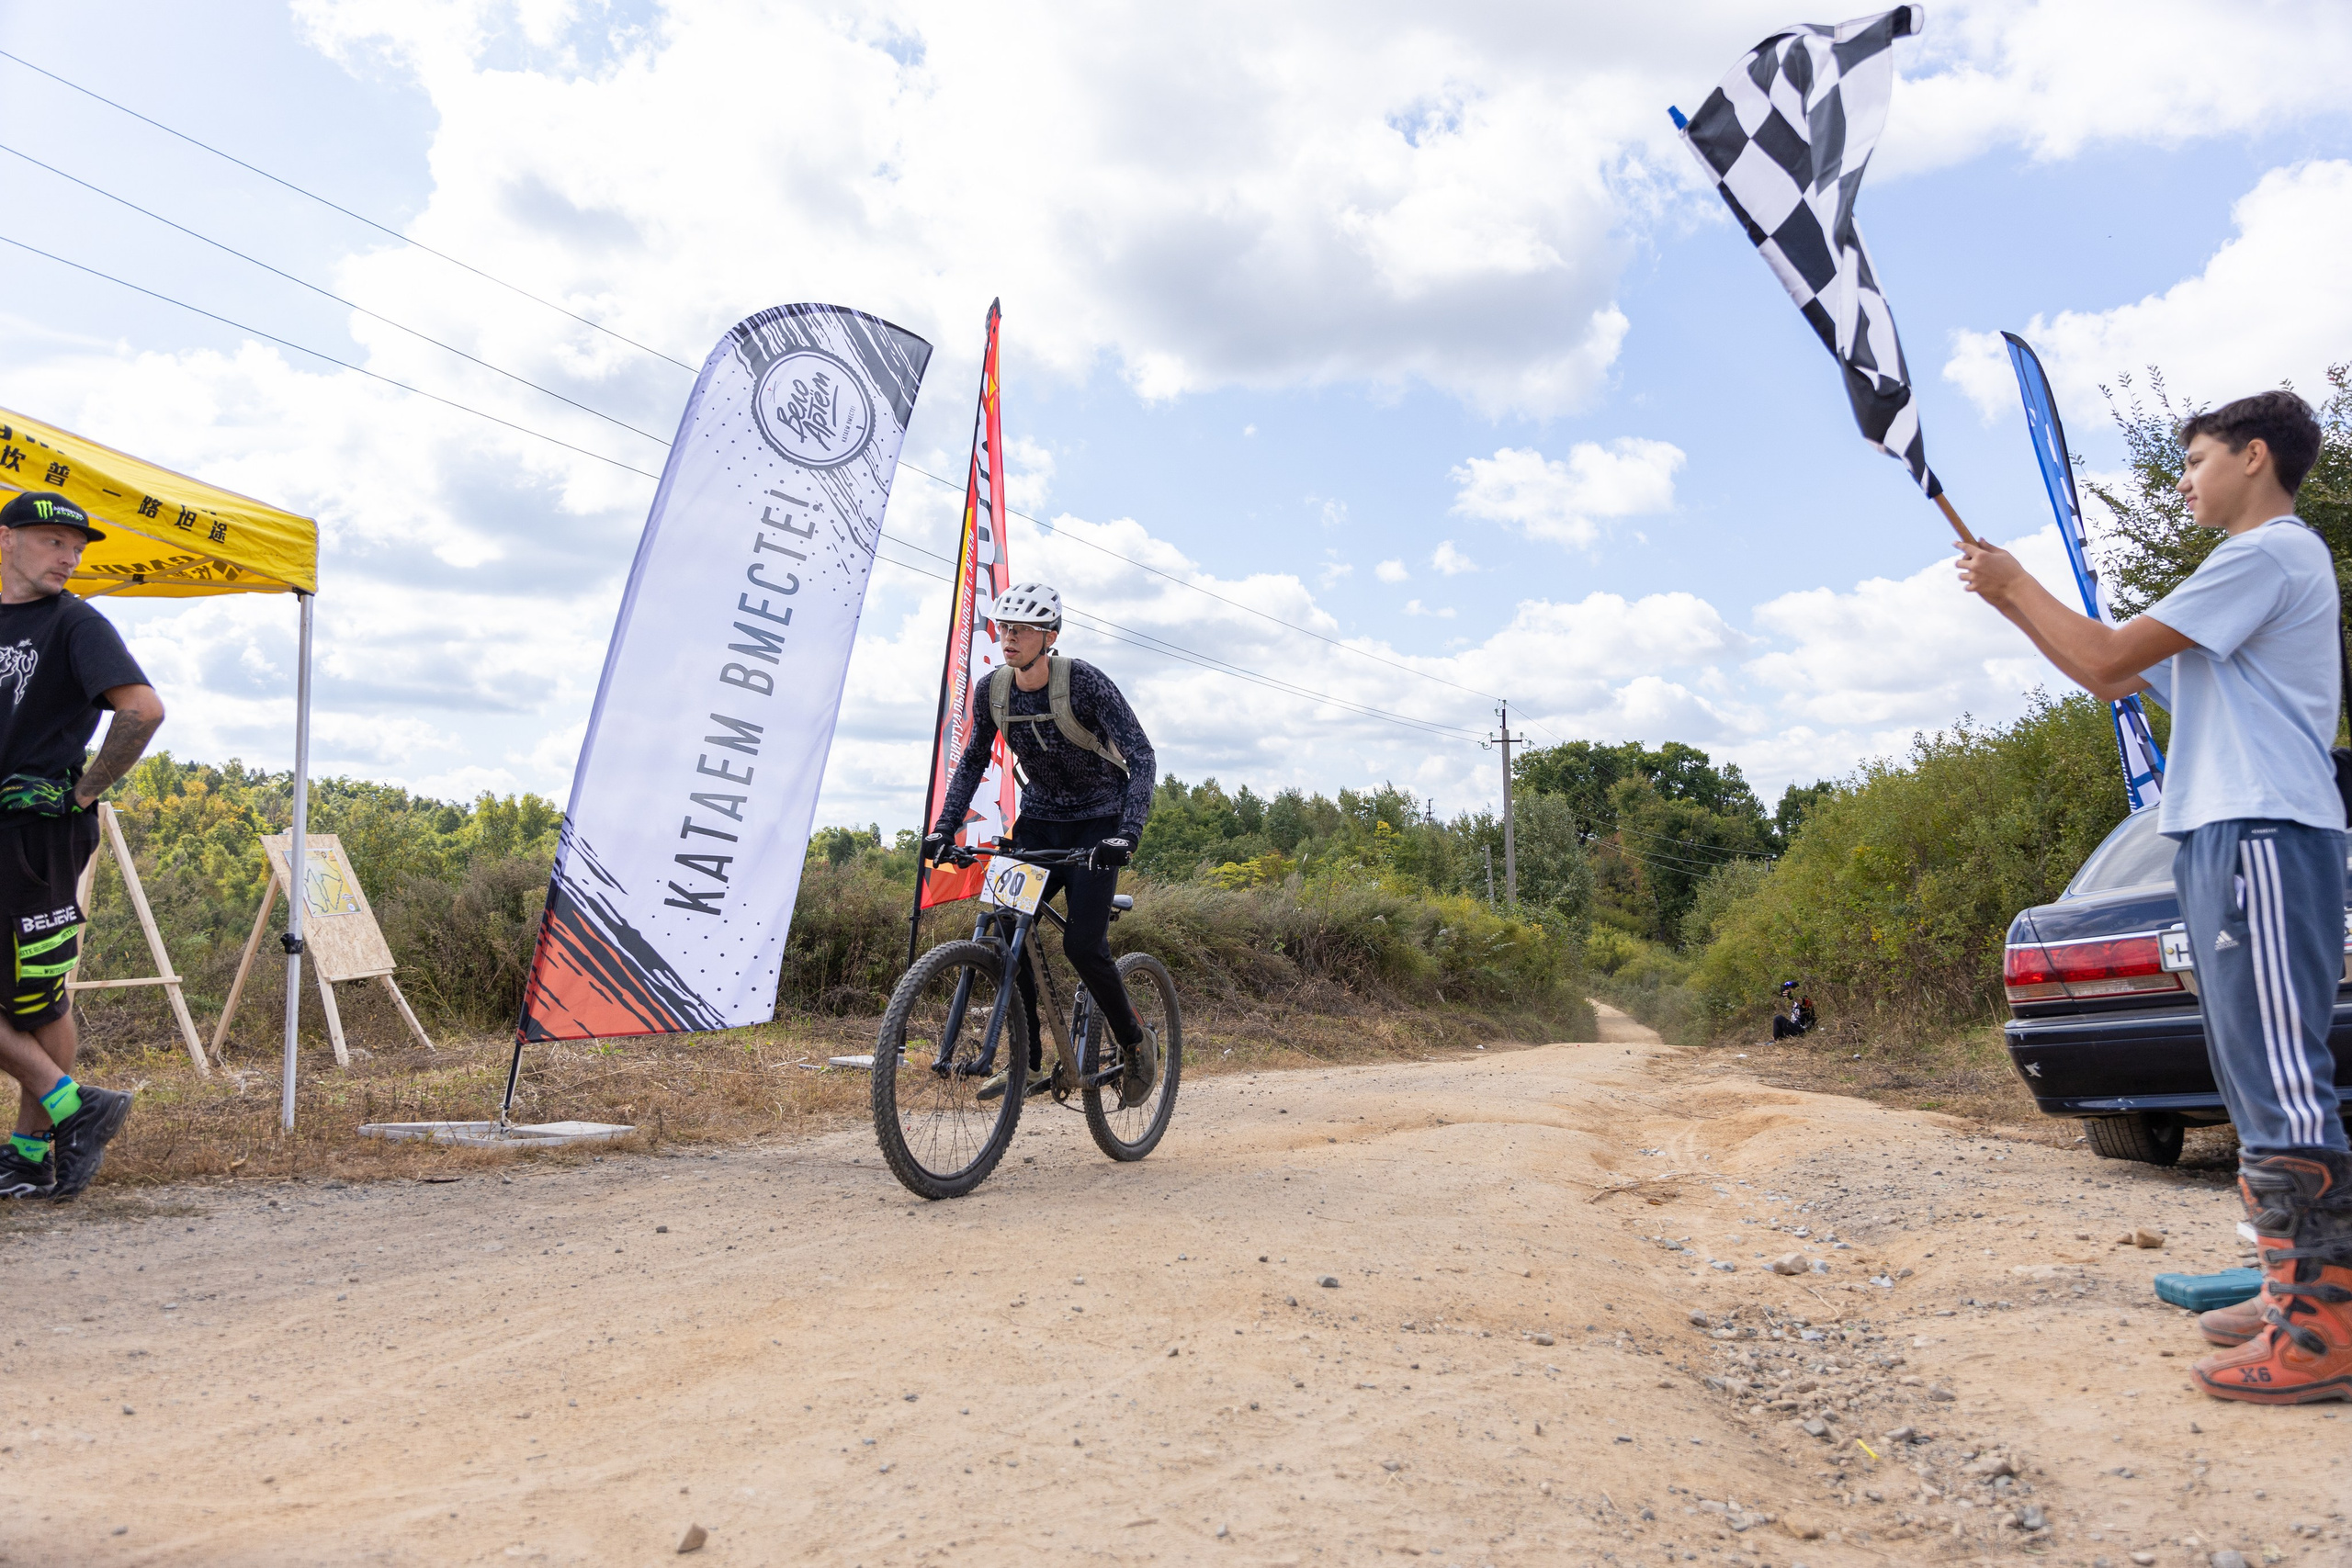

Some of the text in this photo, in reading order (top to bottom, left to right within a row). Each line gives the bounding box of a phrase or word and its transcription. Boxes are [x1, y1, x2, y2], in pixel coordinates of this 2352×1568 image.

[958, 585, 973, 669] РЕАЛЬНОСТИ
[663, 489, 821, 916] КАТАЕМ ВМЕСТЕ!
[21, 905, 78, 934] BELIEVE
